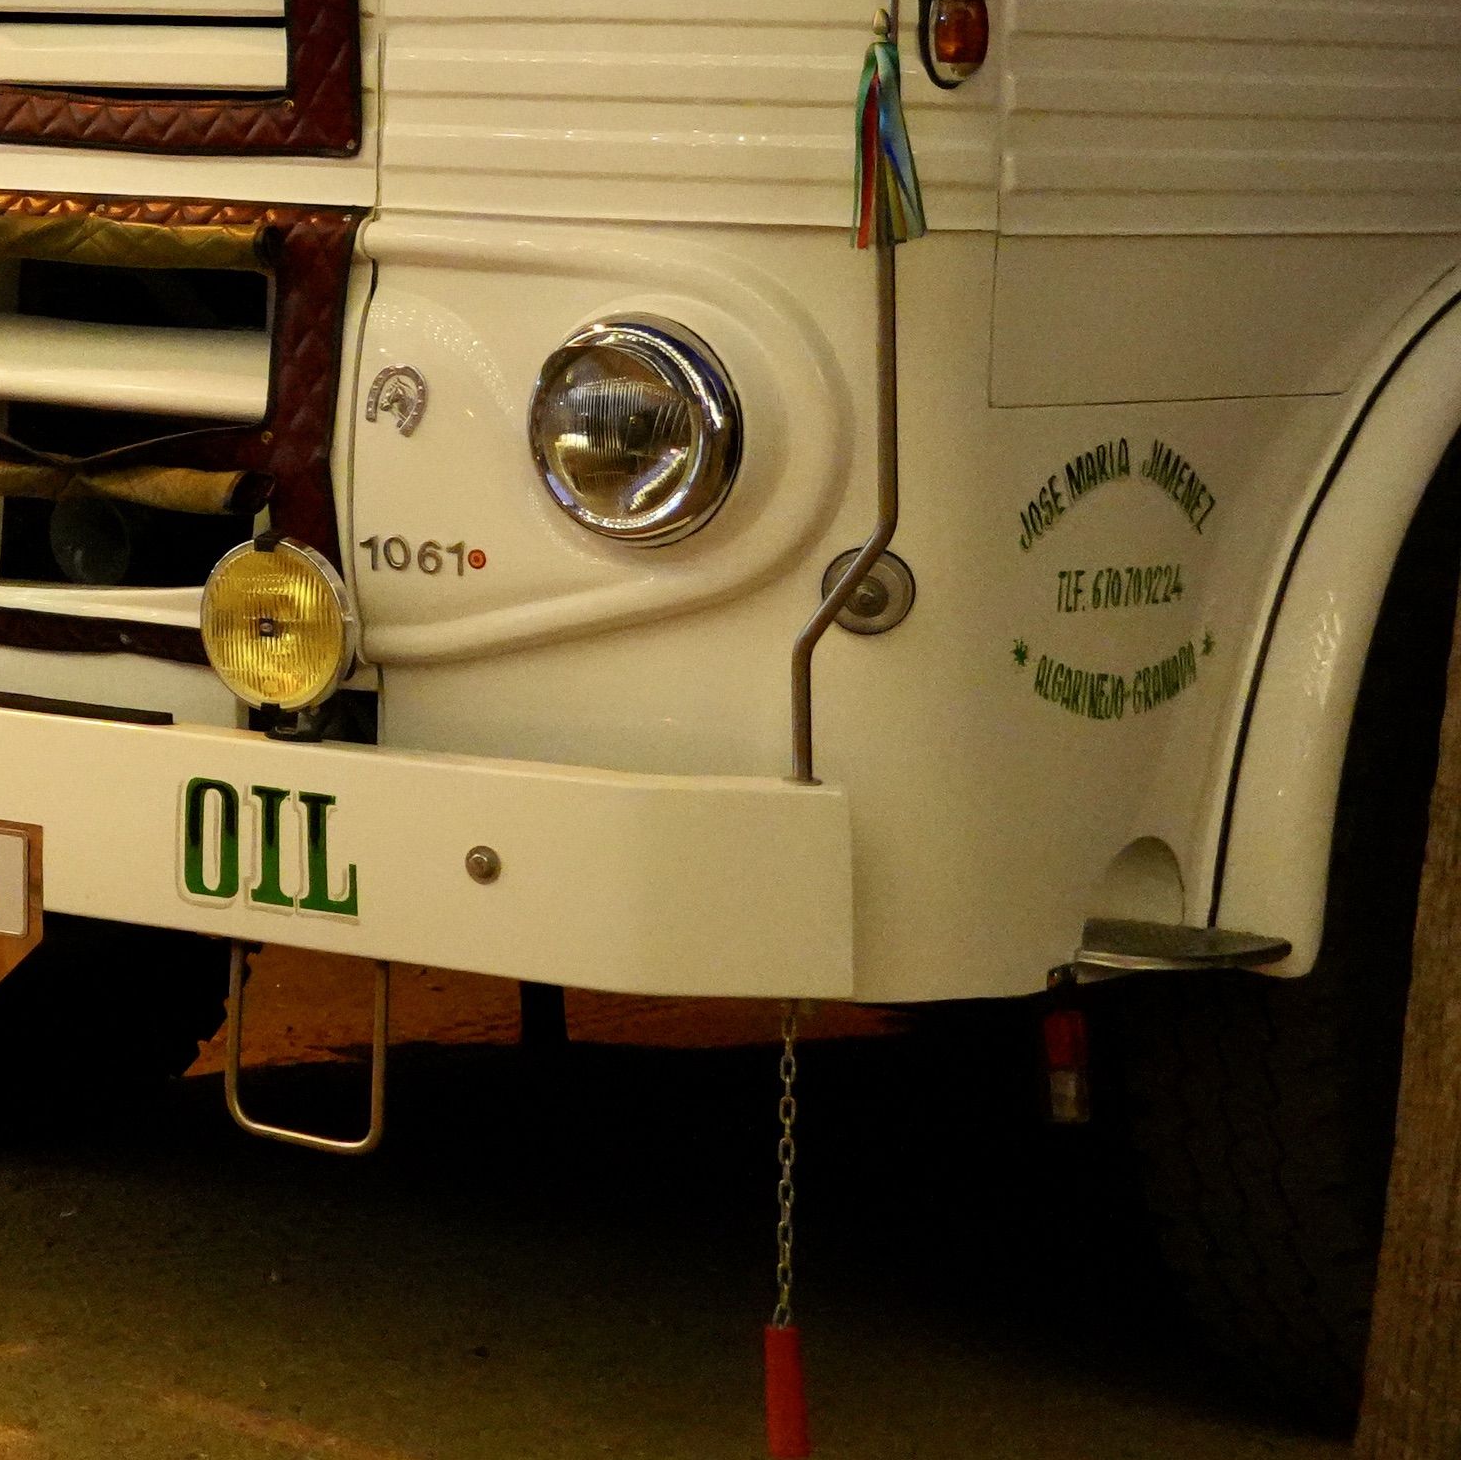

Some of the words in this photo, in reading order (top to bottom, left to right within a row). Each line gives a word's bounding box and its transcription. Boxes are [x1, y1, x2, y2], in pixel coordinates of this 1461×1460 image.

[1019, 474, 1067, 553] JOSE
[1065, 437, 1130, 501] MARIA
[1140, 438, 1216, 535] JIMENEZ
[358, 533, 467, 577] 1061
[178, 776, 360, 919] OIL
